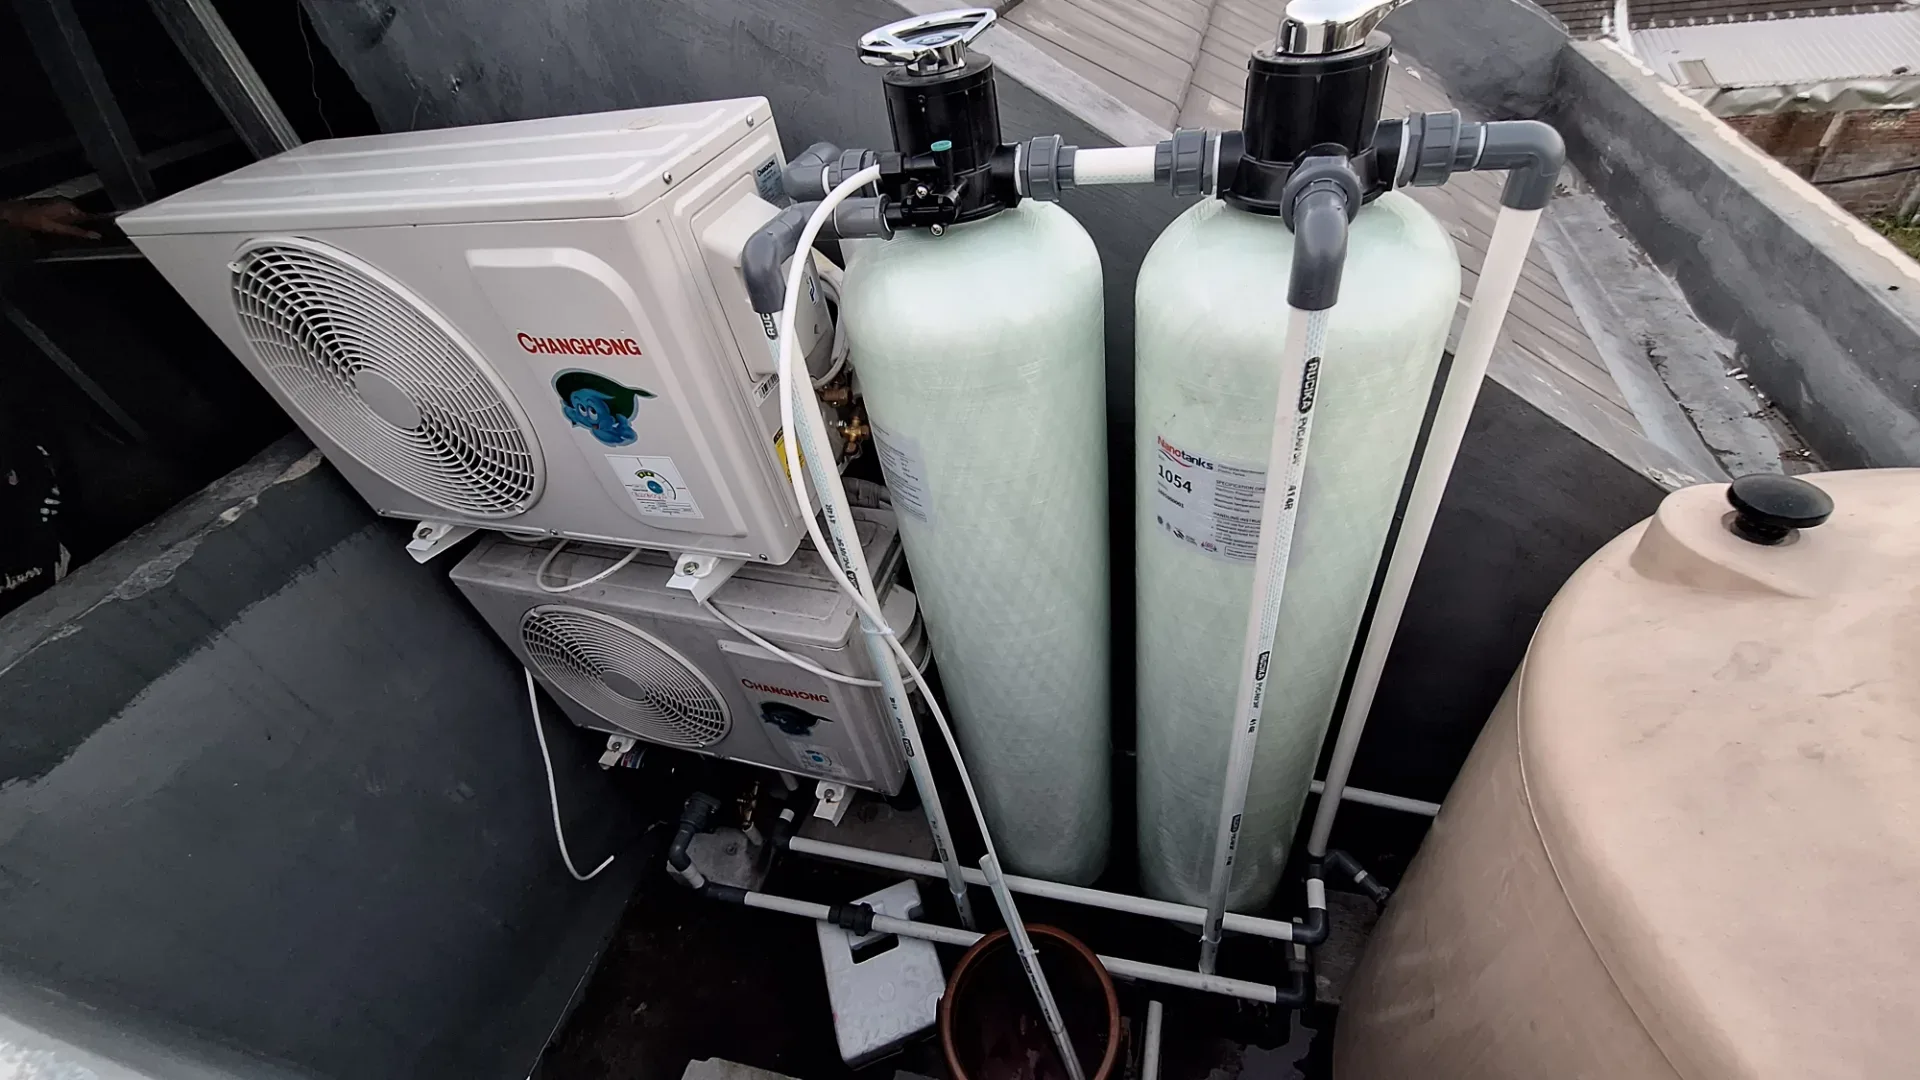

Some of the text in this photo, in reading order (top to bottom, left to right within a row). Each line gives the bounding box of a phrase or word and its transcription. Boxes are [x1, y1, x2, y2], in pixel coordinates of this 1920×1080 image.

[517, 332, 643, 356] CHANGHONG
[1299, 360, 1320, 412] RUCIKA
[1157, 435, 1214, 471] Nanotanks
[1158, 464, 1193, 494] 1054
[741, 678, 830, 703] CHANGHONG
